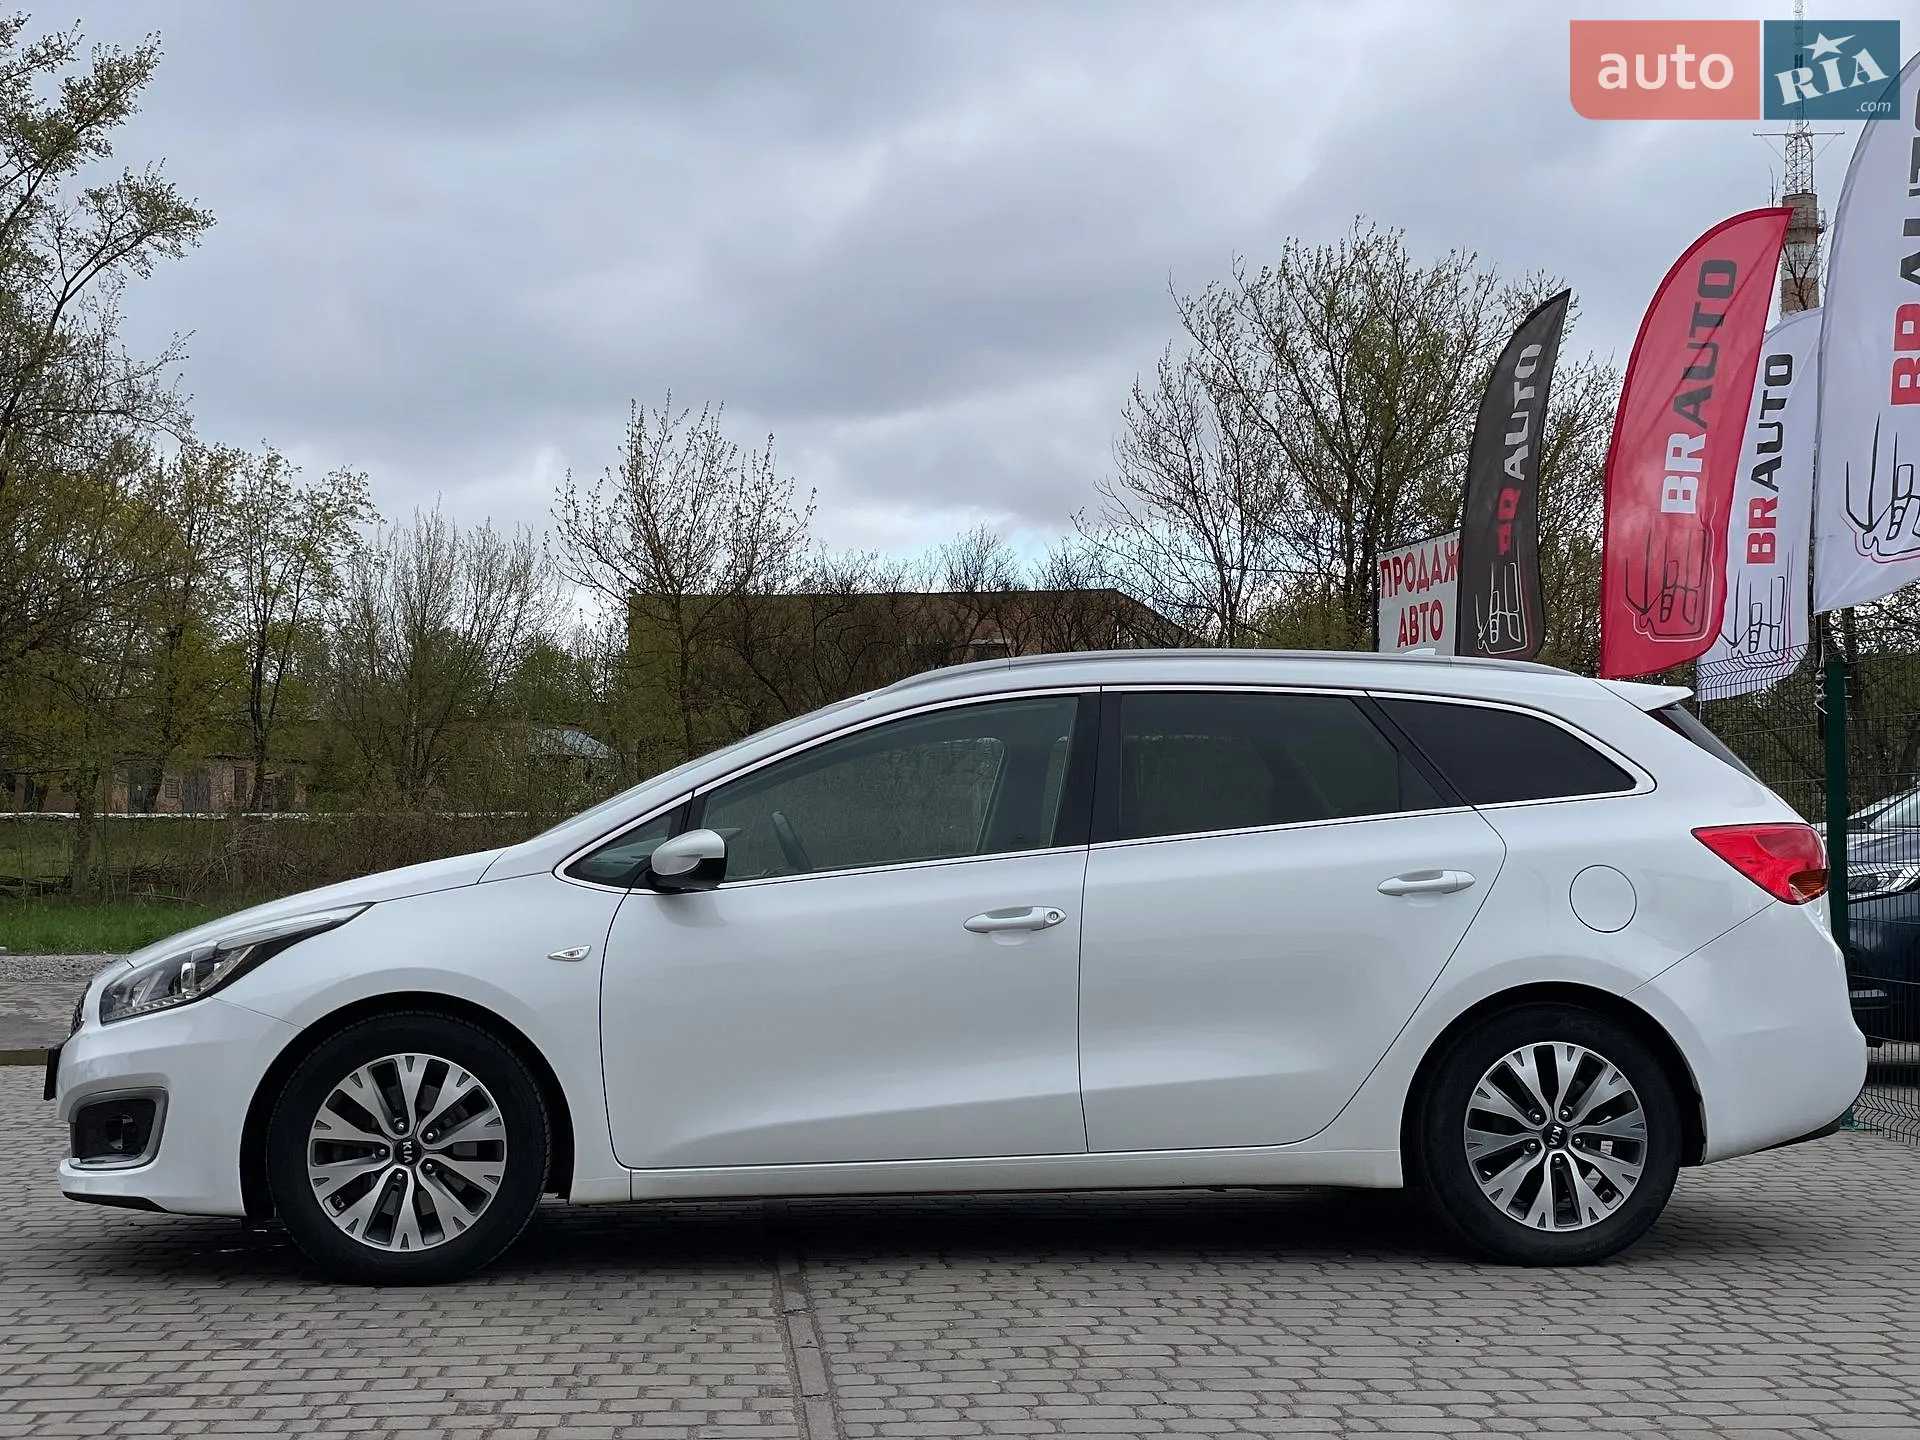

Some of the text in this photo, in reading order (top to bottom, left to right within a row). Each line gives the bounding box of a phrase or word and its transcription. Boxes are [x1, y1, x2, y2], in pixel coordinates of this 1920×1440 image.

[1660, 259, 1738, 515] BRAUTO
[1746, 353, 1794, 565] BRAUTO
[1380, 538, 1460, 599] ПРОДАЖ
[1397, 599, 1444, 648] АВТО
[403, 1141, 412, 1163] KIA
[1549, 1126, 1562, 1145] KIA
